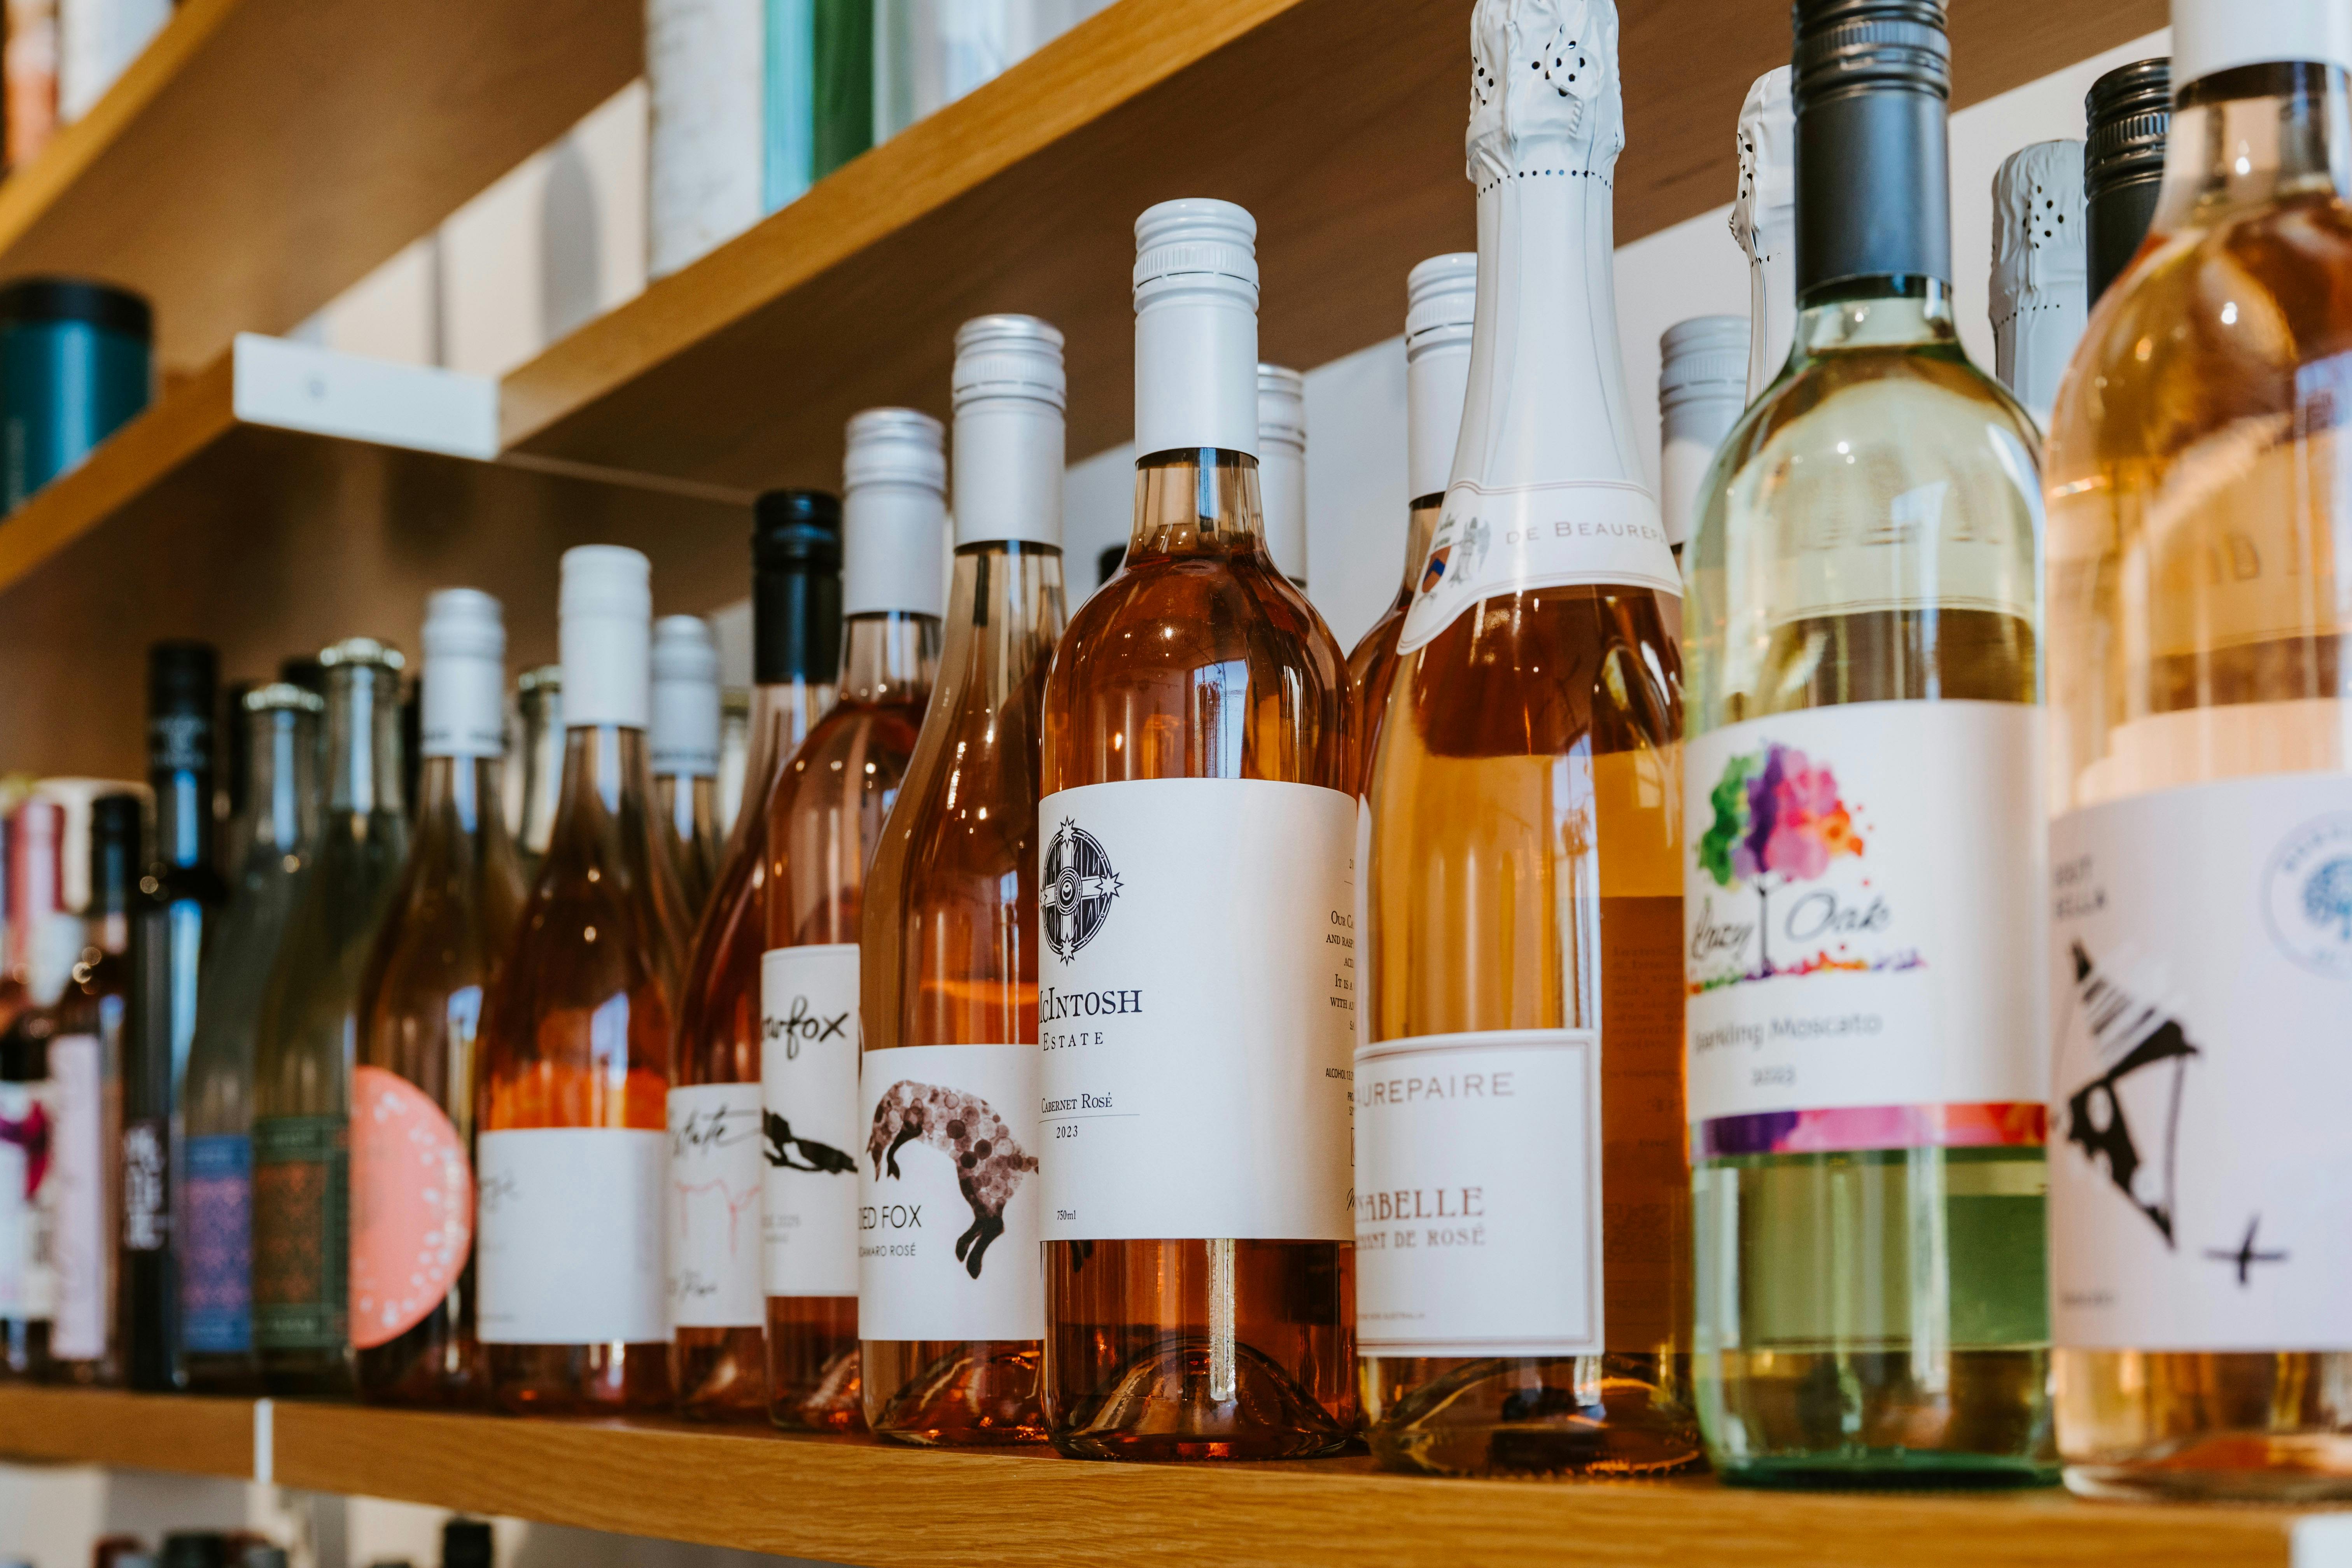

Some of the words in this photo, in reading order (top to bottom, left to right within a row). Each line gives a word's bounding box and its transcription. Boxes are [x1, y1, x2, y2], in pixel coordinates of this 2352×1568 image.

[1506, 527, 1540, 544] DE
[1784, 887, 1892, 942] Oak
[1326, 934, 1340, 945] AND
[1342, 937, 1354, 948] RASP
[1344, 980, 1349, 989] IS
[1330, 997, 1347, 1009] WITH
[1769, 1013, 1883, 1039] Moscato
[1326, 1068, 1346, 1079] ALCOHOL
[1057, 1125, 1078, 1138] 2023
[882, 1205, 921, 1228] FOX
[1057, 1210, 1076, 1220] 750ml
[890, 1242, 916, 1256] ROSÉ
